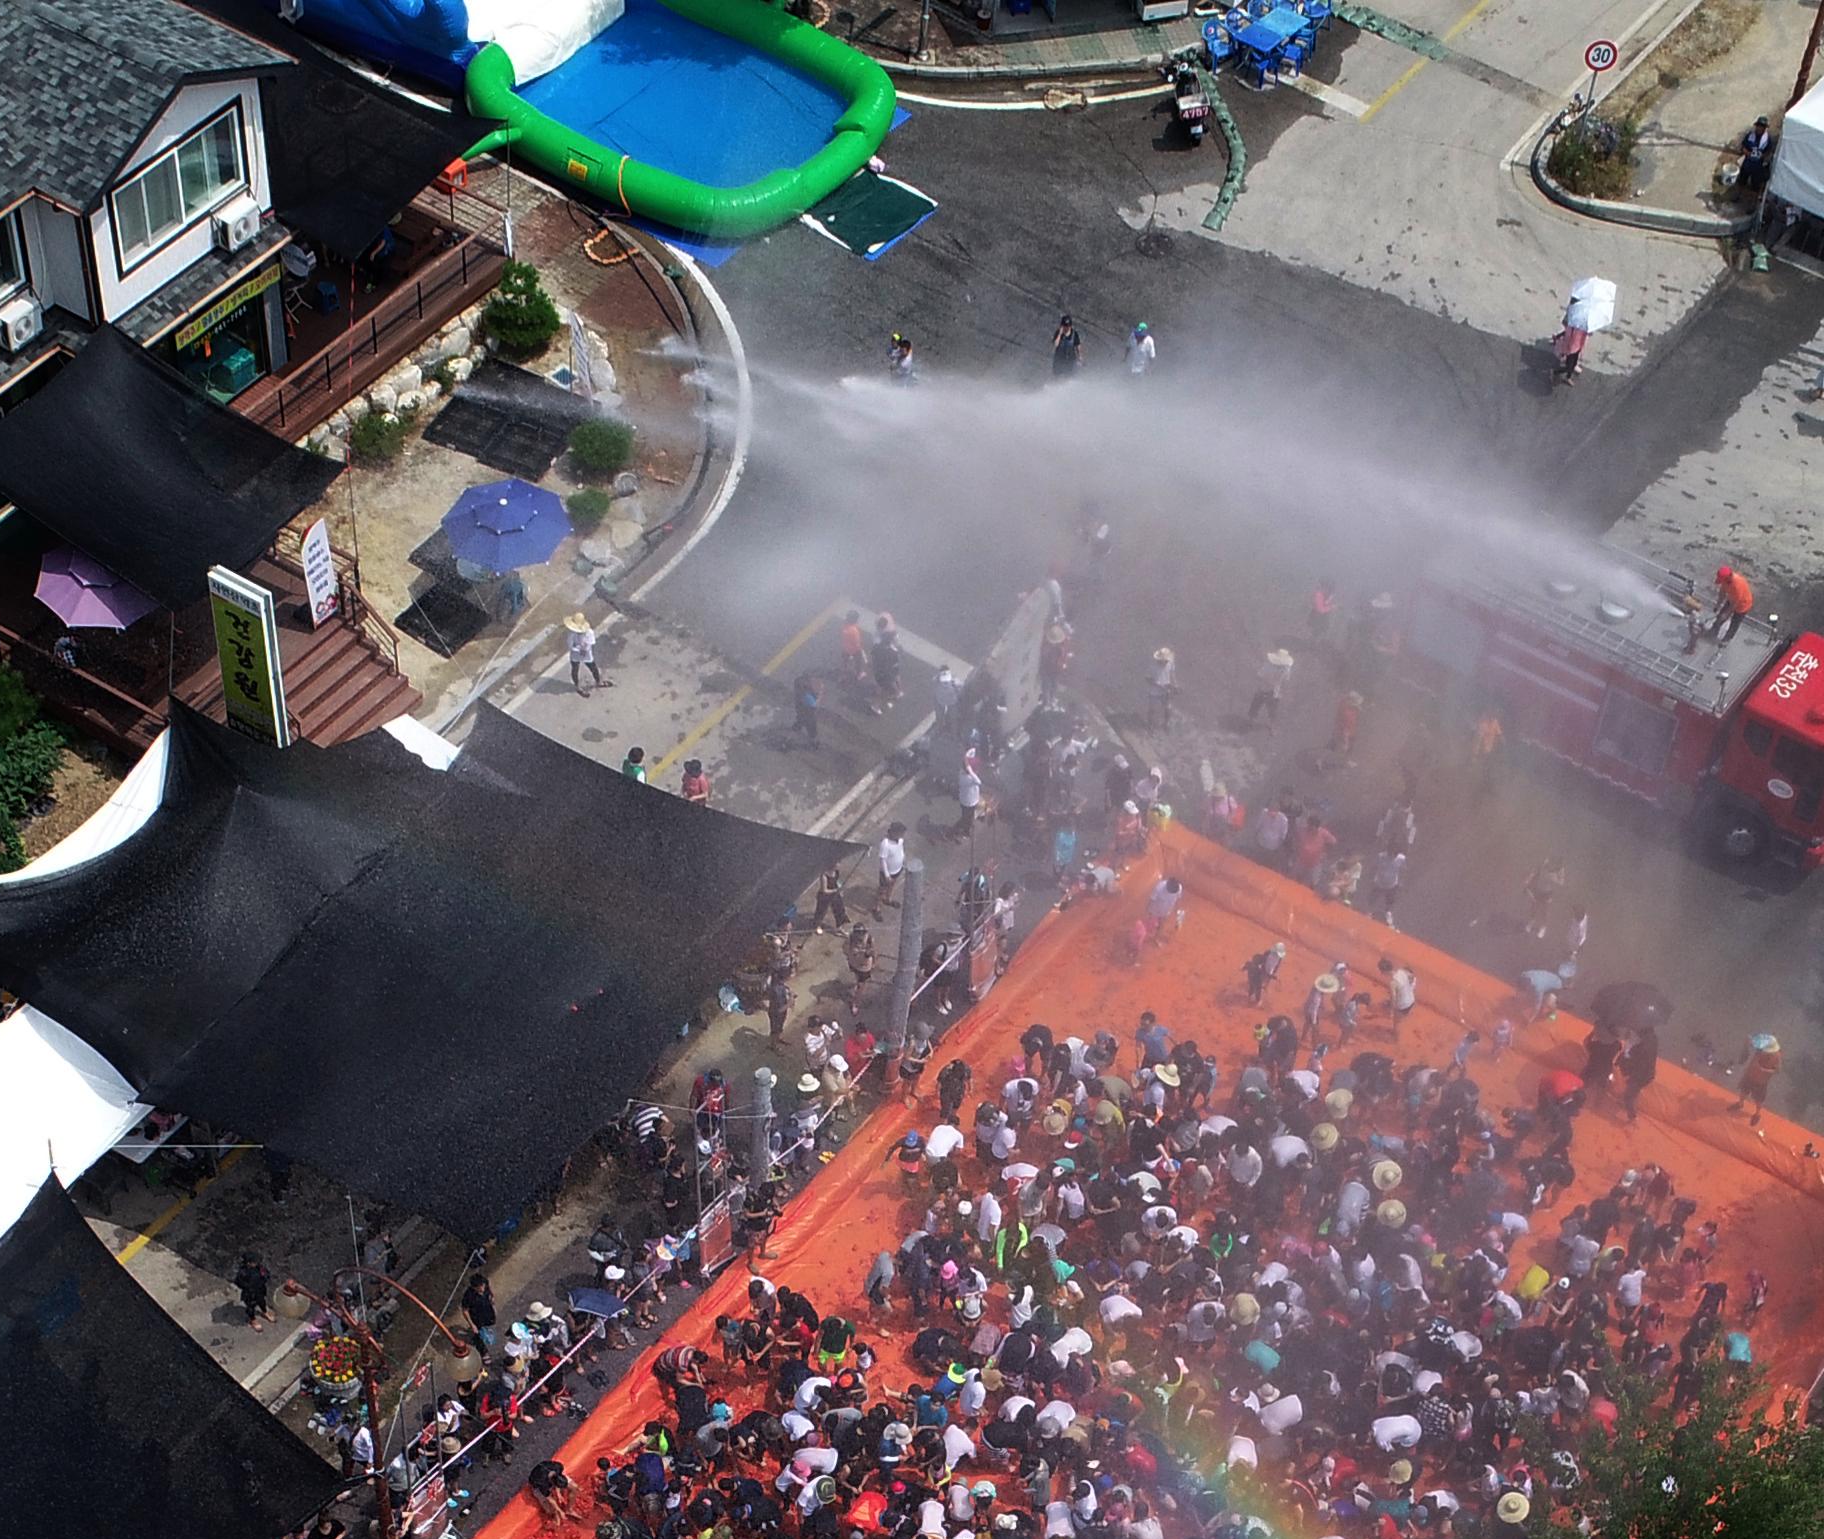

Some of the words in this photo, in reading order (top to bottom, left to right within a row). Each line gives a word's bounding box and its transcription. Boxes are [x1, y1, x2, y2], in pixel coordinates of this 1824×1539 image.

[1591, 47, 1611, 63] 30
[225, 609, 260, 703] 건강원
[1768, 650, 1819, 699] 춘천32
